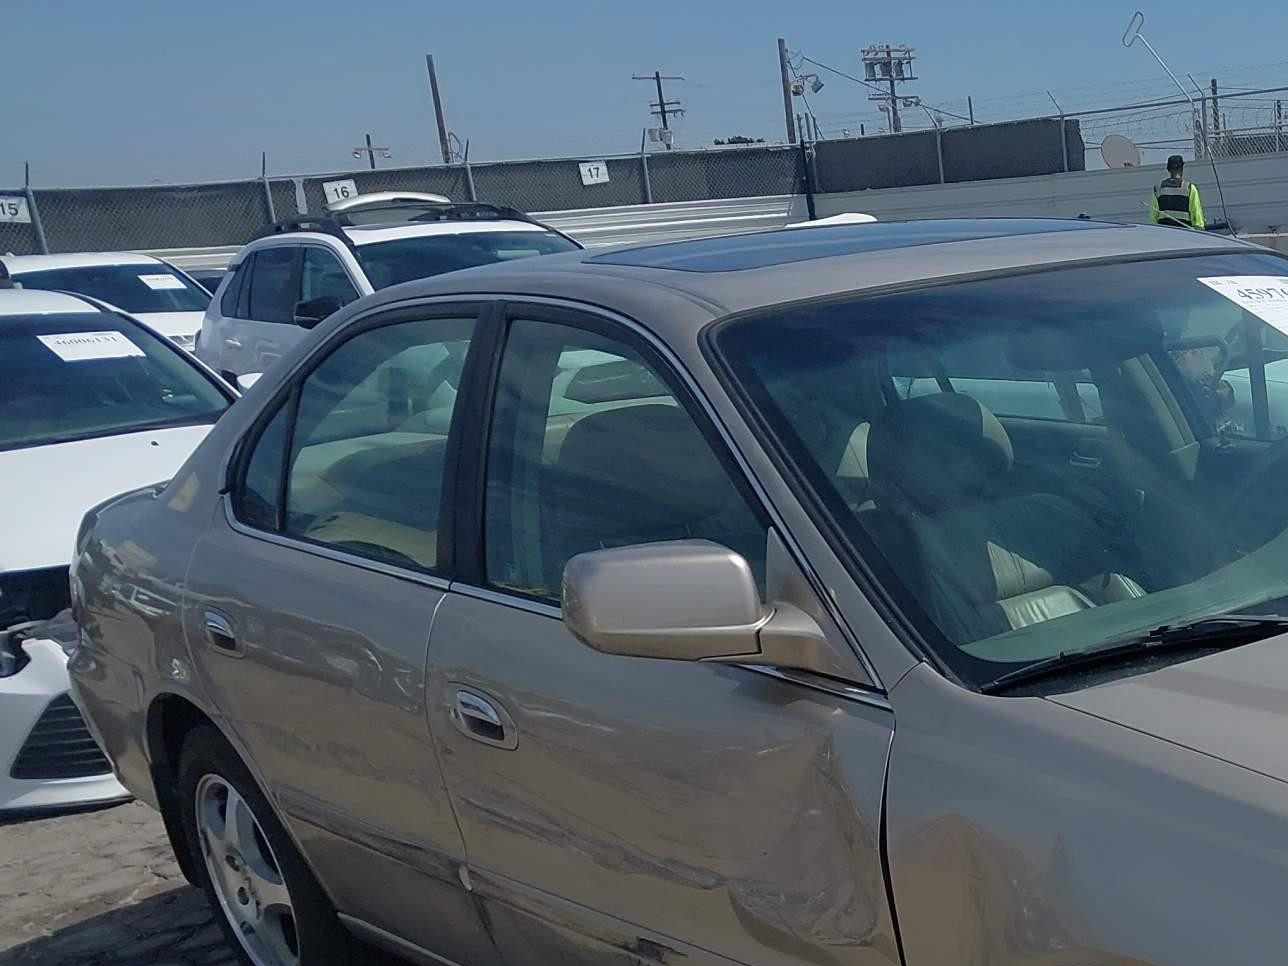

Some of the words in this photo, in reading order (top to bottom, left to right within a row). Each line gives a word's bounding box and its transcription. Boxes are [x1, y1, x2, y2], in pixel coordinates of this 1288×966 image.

[587, 167, 600, 179] 17
[333, 186, 350, 199] 16
[0, 202, 19, 216] 15
